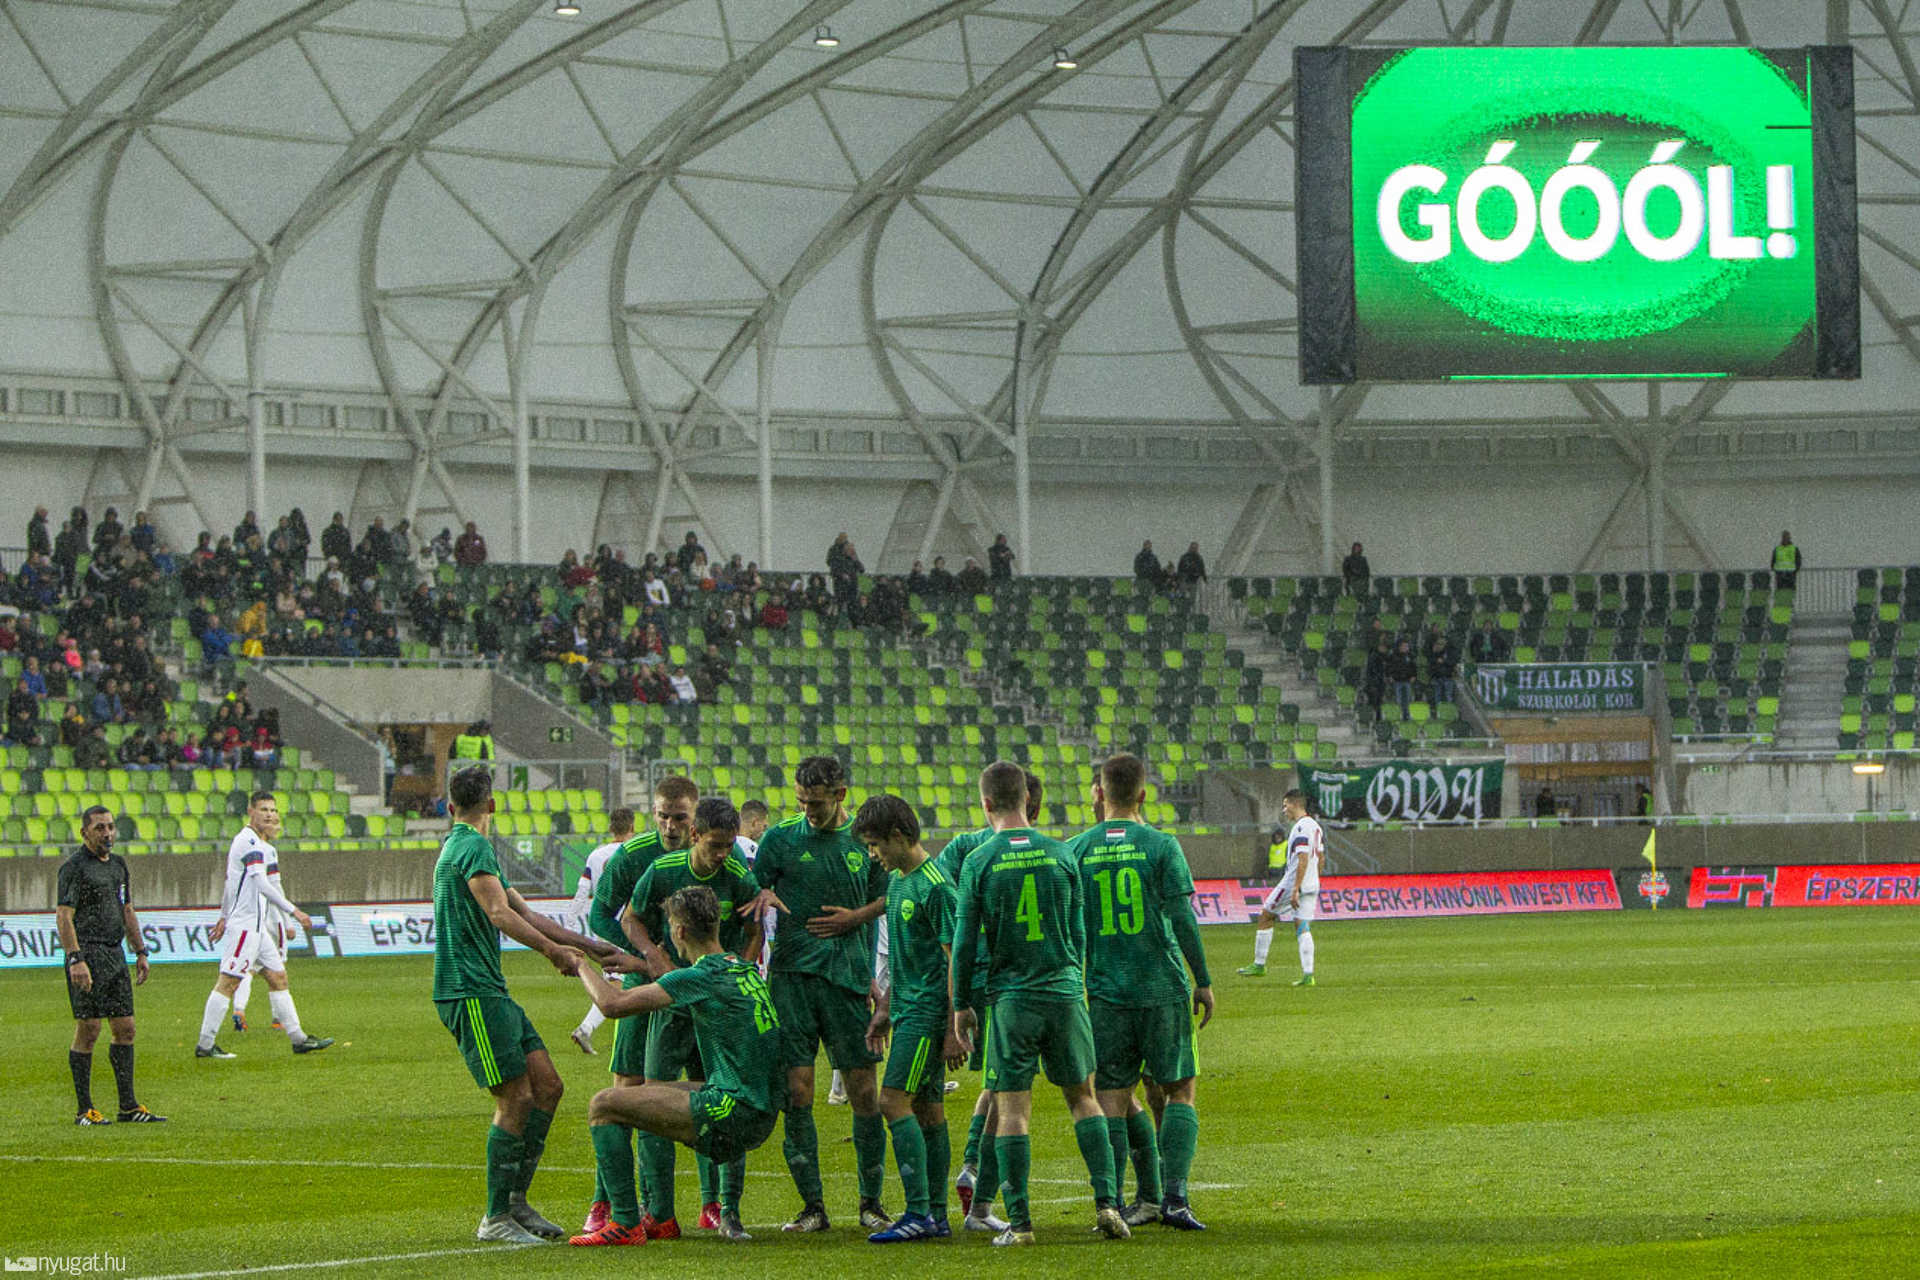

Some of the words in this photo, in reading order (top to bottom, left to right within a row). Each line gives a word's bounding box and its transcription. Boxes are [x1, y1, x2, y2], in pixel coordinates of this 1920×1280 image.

[1377, 140, 1797, 263] GÓÓÓL!
[1518, 666, 1634, 689] HALADÁS
[1016, 873, 1044, 941] 4
[1093, 867, 1145, 936] 19
[1508, 882, 1573, 906] INVEST
[185, 925, 217, 952] KF
